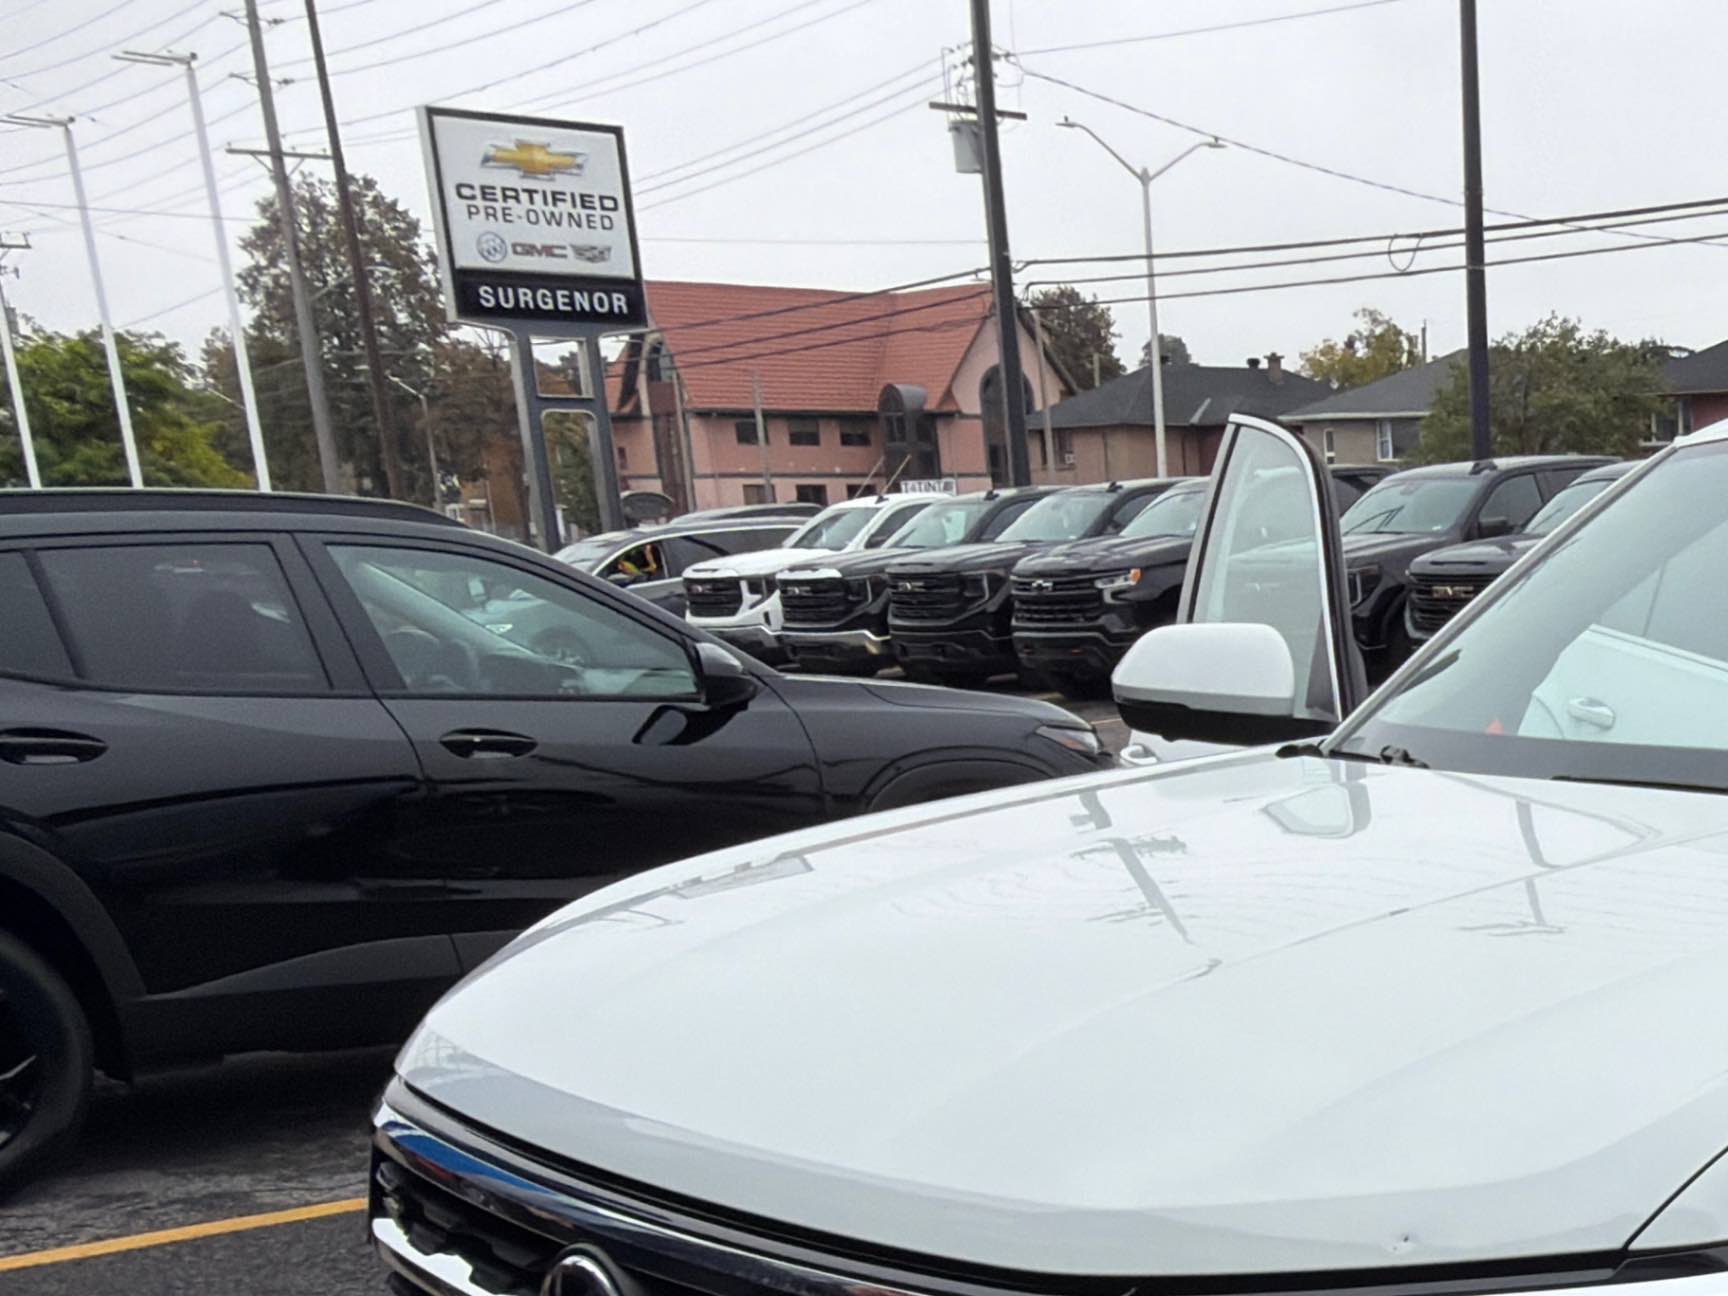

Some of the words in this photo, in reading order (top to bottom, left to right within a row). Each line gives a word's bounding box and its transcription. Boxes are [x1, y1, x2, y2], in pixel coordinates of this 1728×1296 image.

[456, 183, 618, 211] CERTIFIED
[468, 205, 613, 230] PRE-OWNED
[511, 242, 568, 259] GMC
[478, 285, 629, 315] SURGENOR
